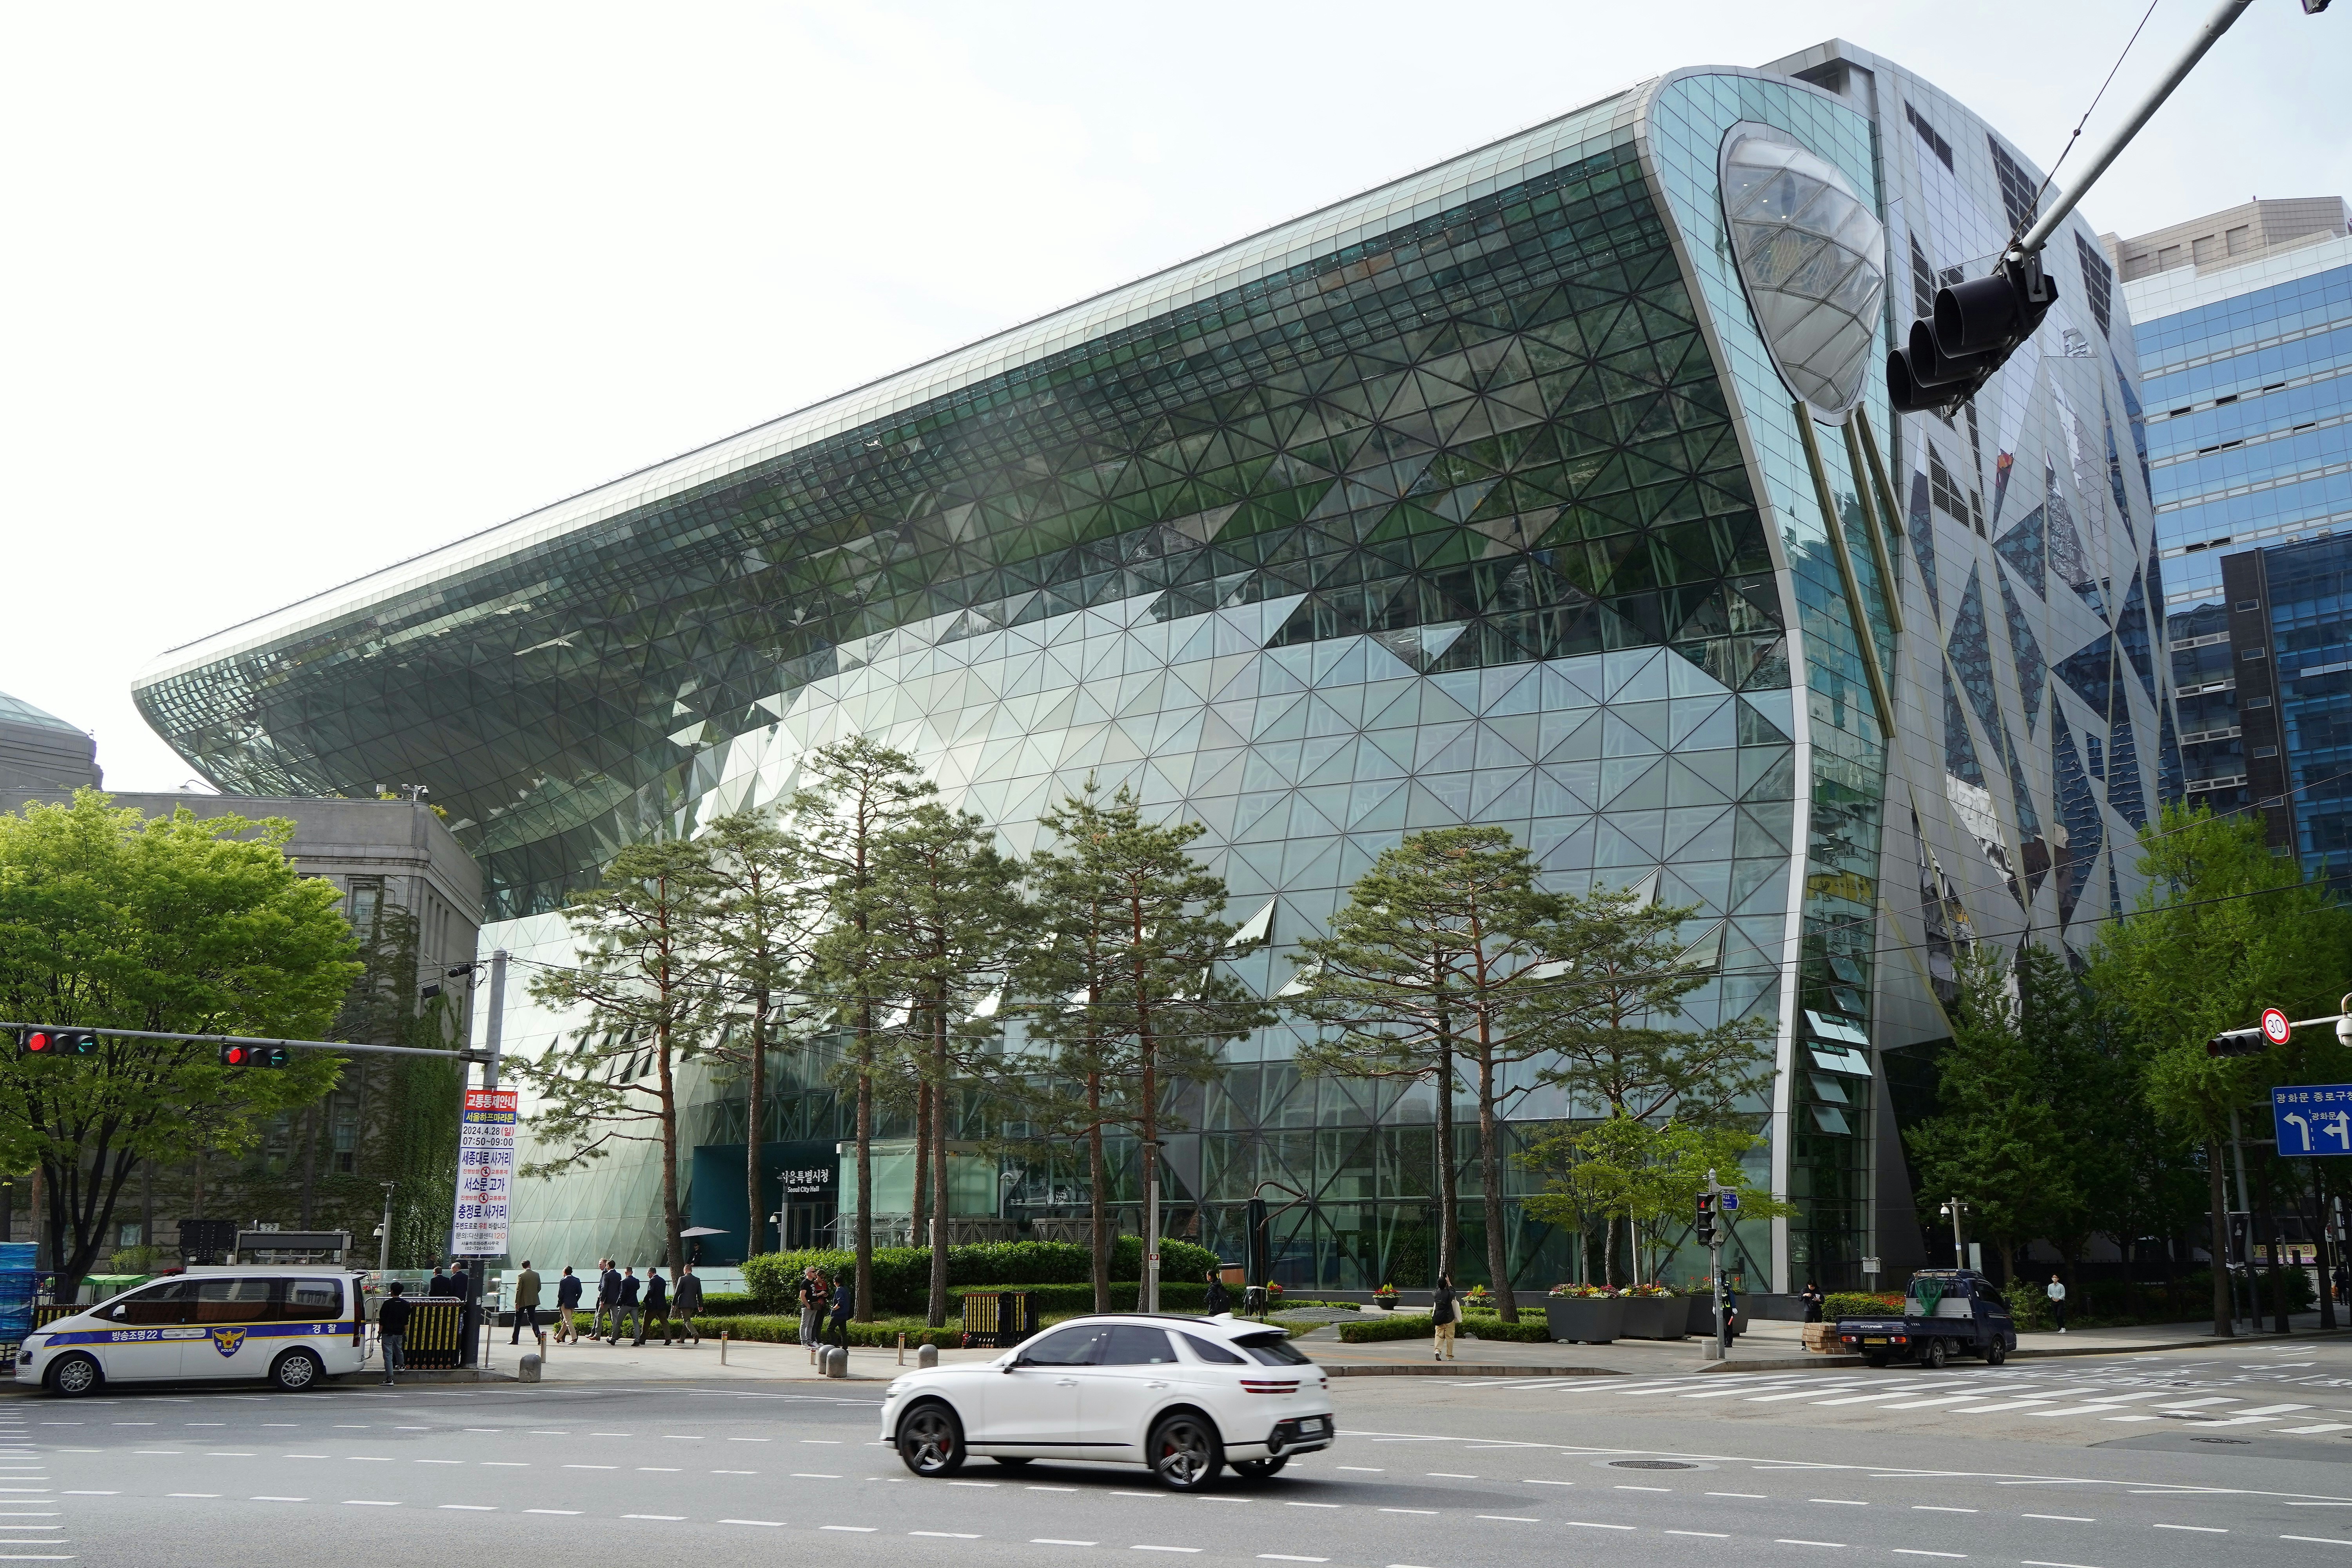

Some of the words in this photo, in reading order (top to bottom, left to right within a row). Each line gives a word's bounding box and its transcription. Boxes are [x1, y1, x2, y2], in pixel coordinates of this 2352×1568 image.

[2268, 1020, 2283, 1033] 30
[467, 1094, 516, 1109] 교통통제안내
[2276, 1093, 2309, 1103] 광화문
[466, 1112, 514, 1123] 서울하프마라톤
[2312, 1112, 2337, 1120] 광화문
[463, 1137, 513, 1146] 07:50~09:00
[462, 1151, 489, 1165] 세종대로
[491, 1152, 511, 1166] 사거리
[464, 1177, 487, 1192] 서소문
[489, 1178, 505, 1192] 고가
[458, 1204, 481, 1219] 충정로
[484, 1205, 507, 1219] 사거리
